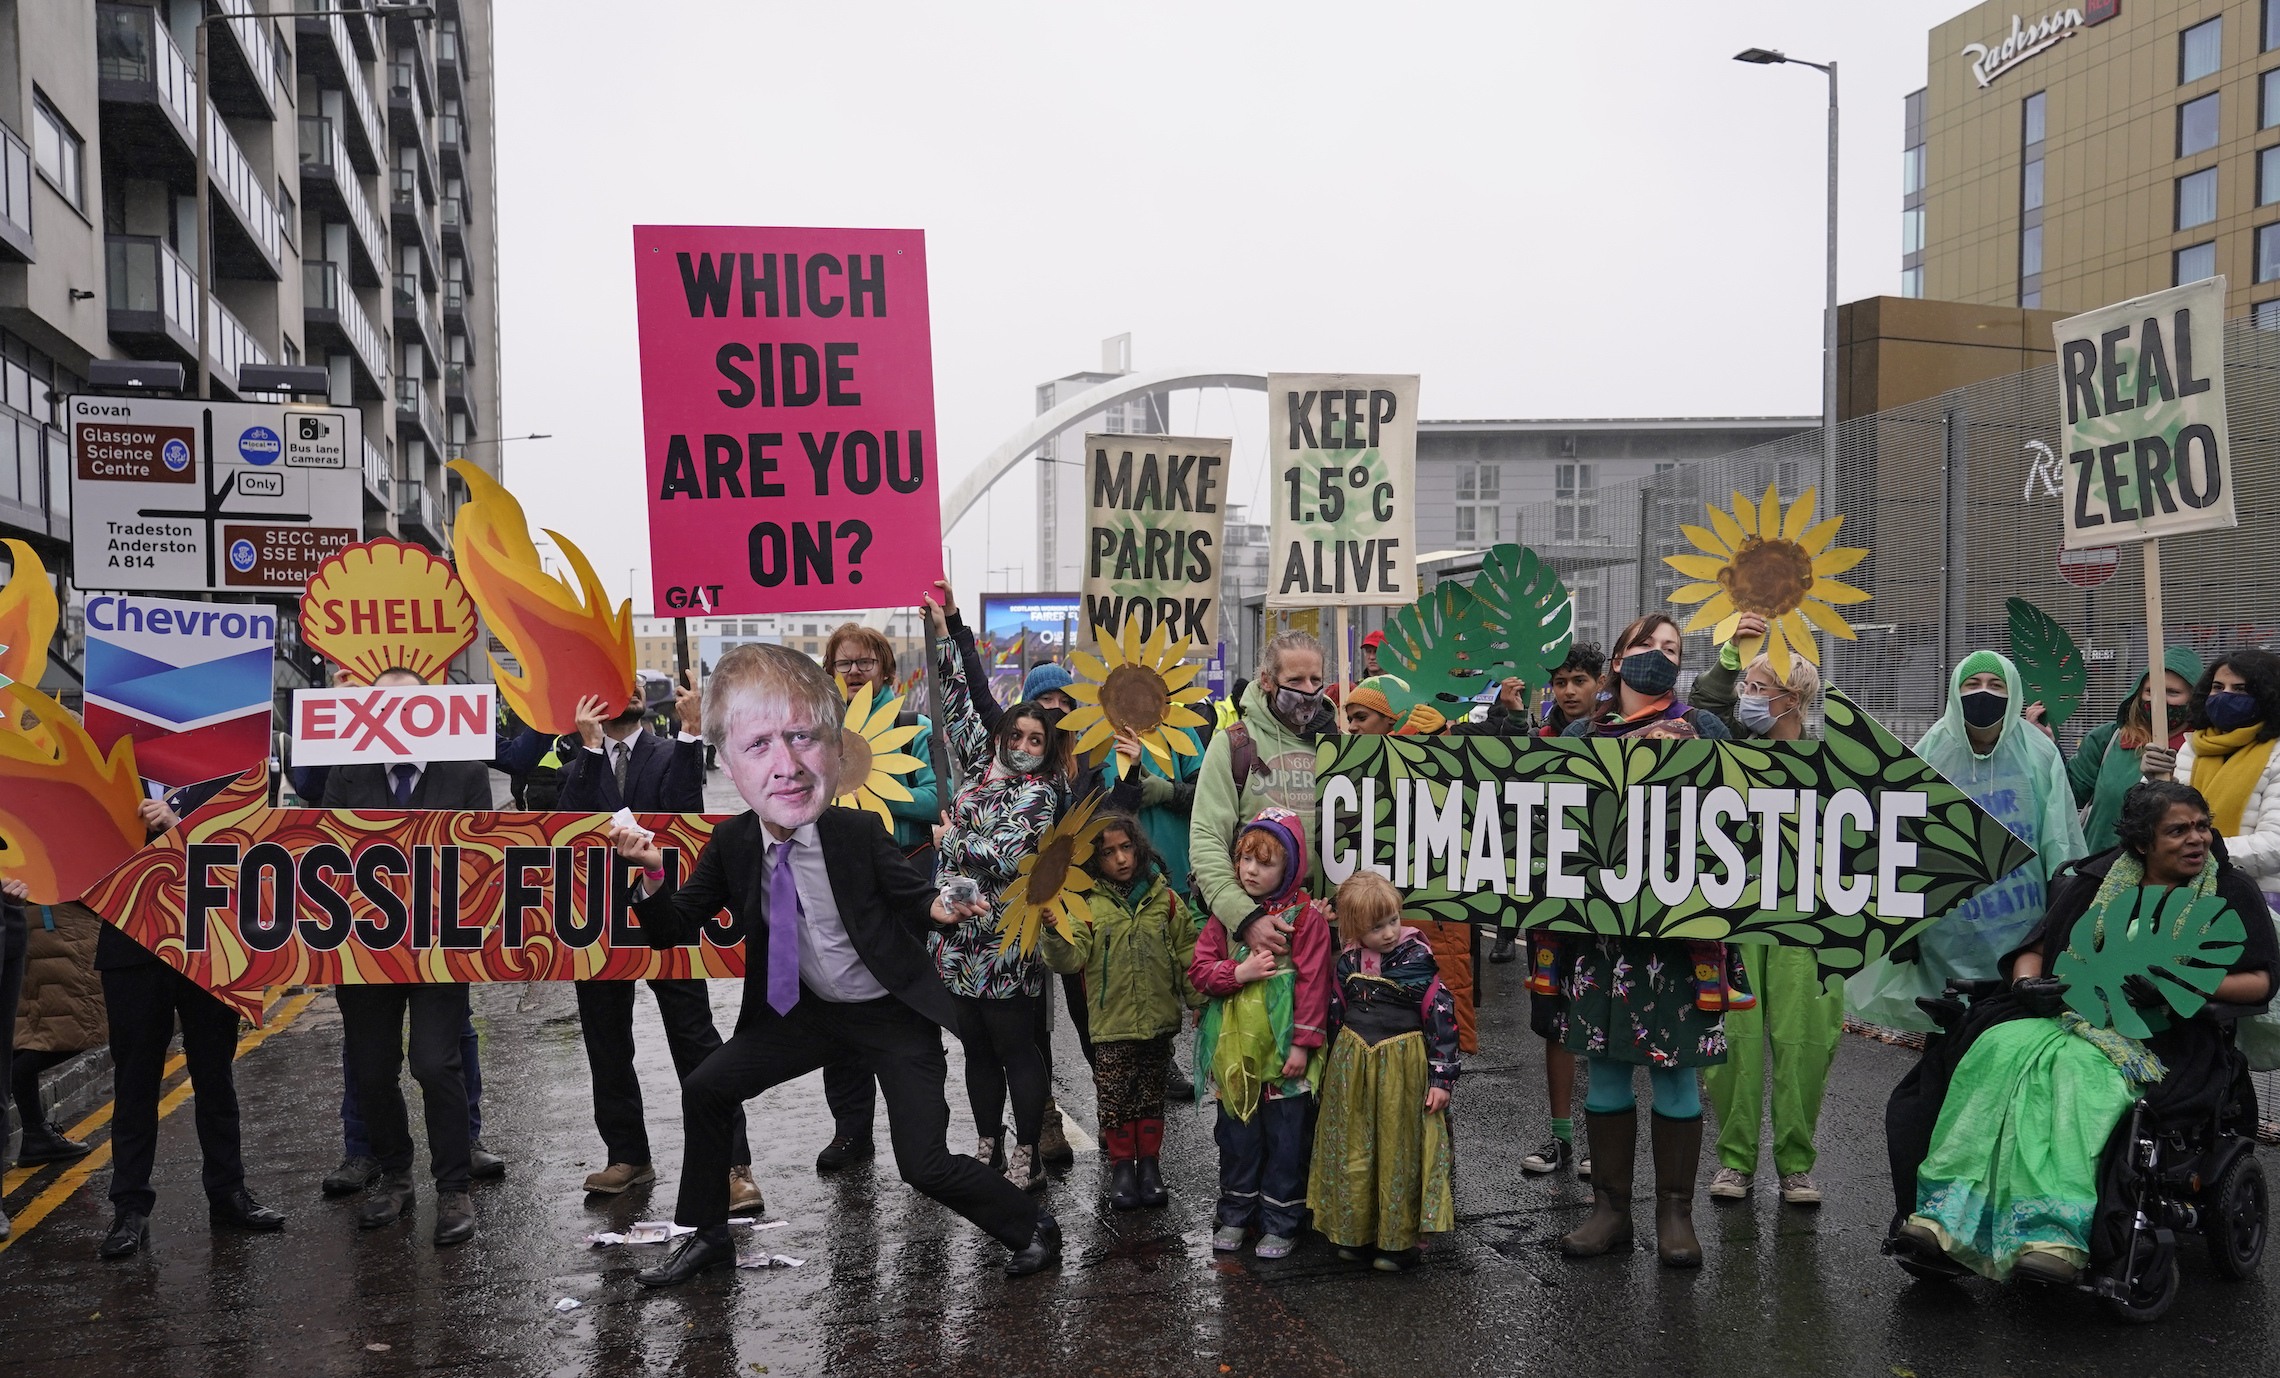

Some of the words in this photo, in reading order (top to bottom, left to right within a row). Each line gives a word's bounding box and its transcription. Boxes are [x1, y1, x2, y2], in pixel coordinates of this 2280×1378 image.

[1961, 8, 2085, 87] Radisson
[676, 252, 887, 318] WHICH
[716, 342, 862, 409] SIDE
[2063, 308, 2210, 425] REAL
[76, 402, 131, 417] Govan
[1288, 389, 1397, 449] KEEP
[82, 428, 157, 445] Glasgow
[87, 446, 154, 461] Science
[290, 443, 311, 454] Bus
[316, 445, 340, 455] lane
[91, 461, 150, 476] Centre
[291, 455, 339, 465] cameras
[660, 433, 785, 500] ARE
[798, 430, 924, 496] YOU
[1093, 449, 1221, 513] MAKE
[2069, 424, 2221, 529] ZERO
[245, 478, 276, 491] Only
[107, 522, 193, 536] Tradeston
[108, 539, 197, 553] Anderston
[265, 531, 314, 546] SECC
[319, 533, 349, 546] and
[108, 556, 120, 568] A
[124, 556, 155, 569] 814
[262, 547, 297, 561] SSE
[748, 519, 873, 587] ON?
[1091, 527, 1212, 583] PARIS
[1280, 538, 1400, 594] ALIVE
[86, 596, 275, 640] Chevron
[323, 599, 457, 635] SHELL
[665, 585, 724, 609] GAT
[1086, 594, 1212, 645] WORK
[301, 690, 489, 755] EXXON
[1251, 769, 1316, 792] SUPER
[1321, 774, 1586, 900] CLIMATE
[1599, 785, 1928, 919] JUSTICE
[185, 842, 485, 952] FOSSIL
[1961, 881, 2042, 921] DEATH
